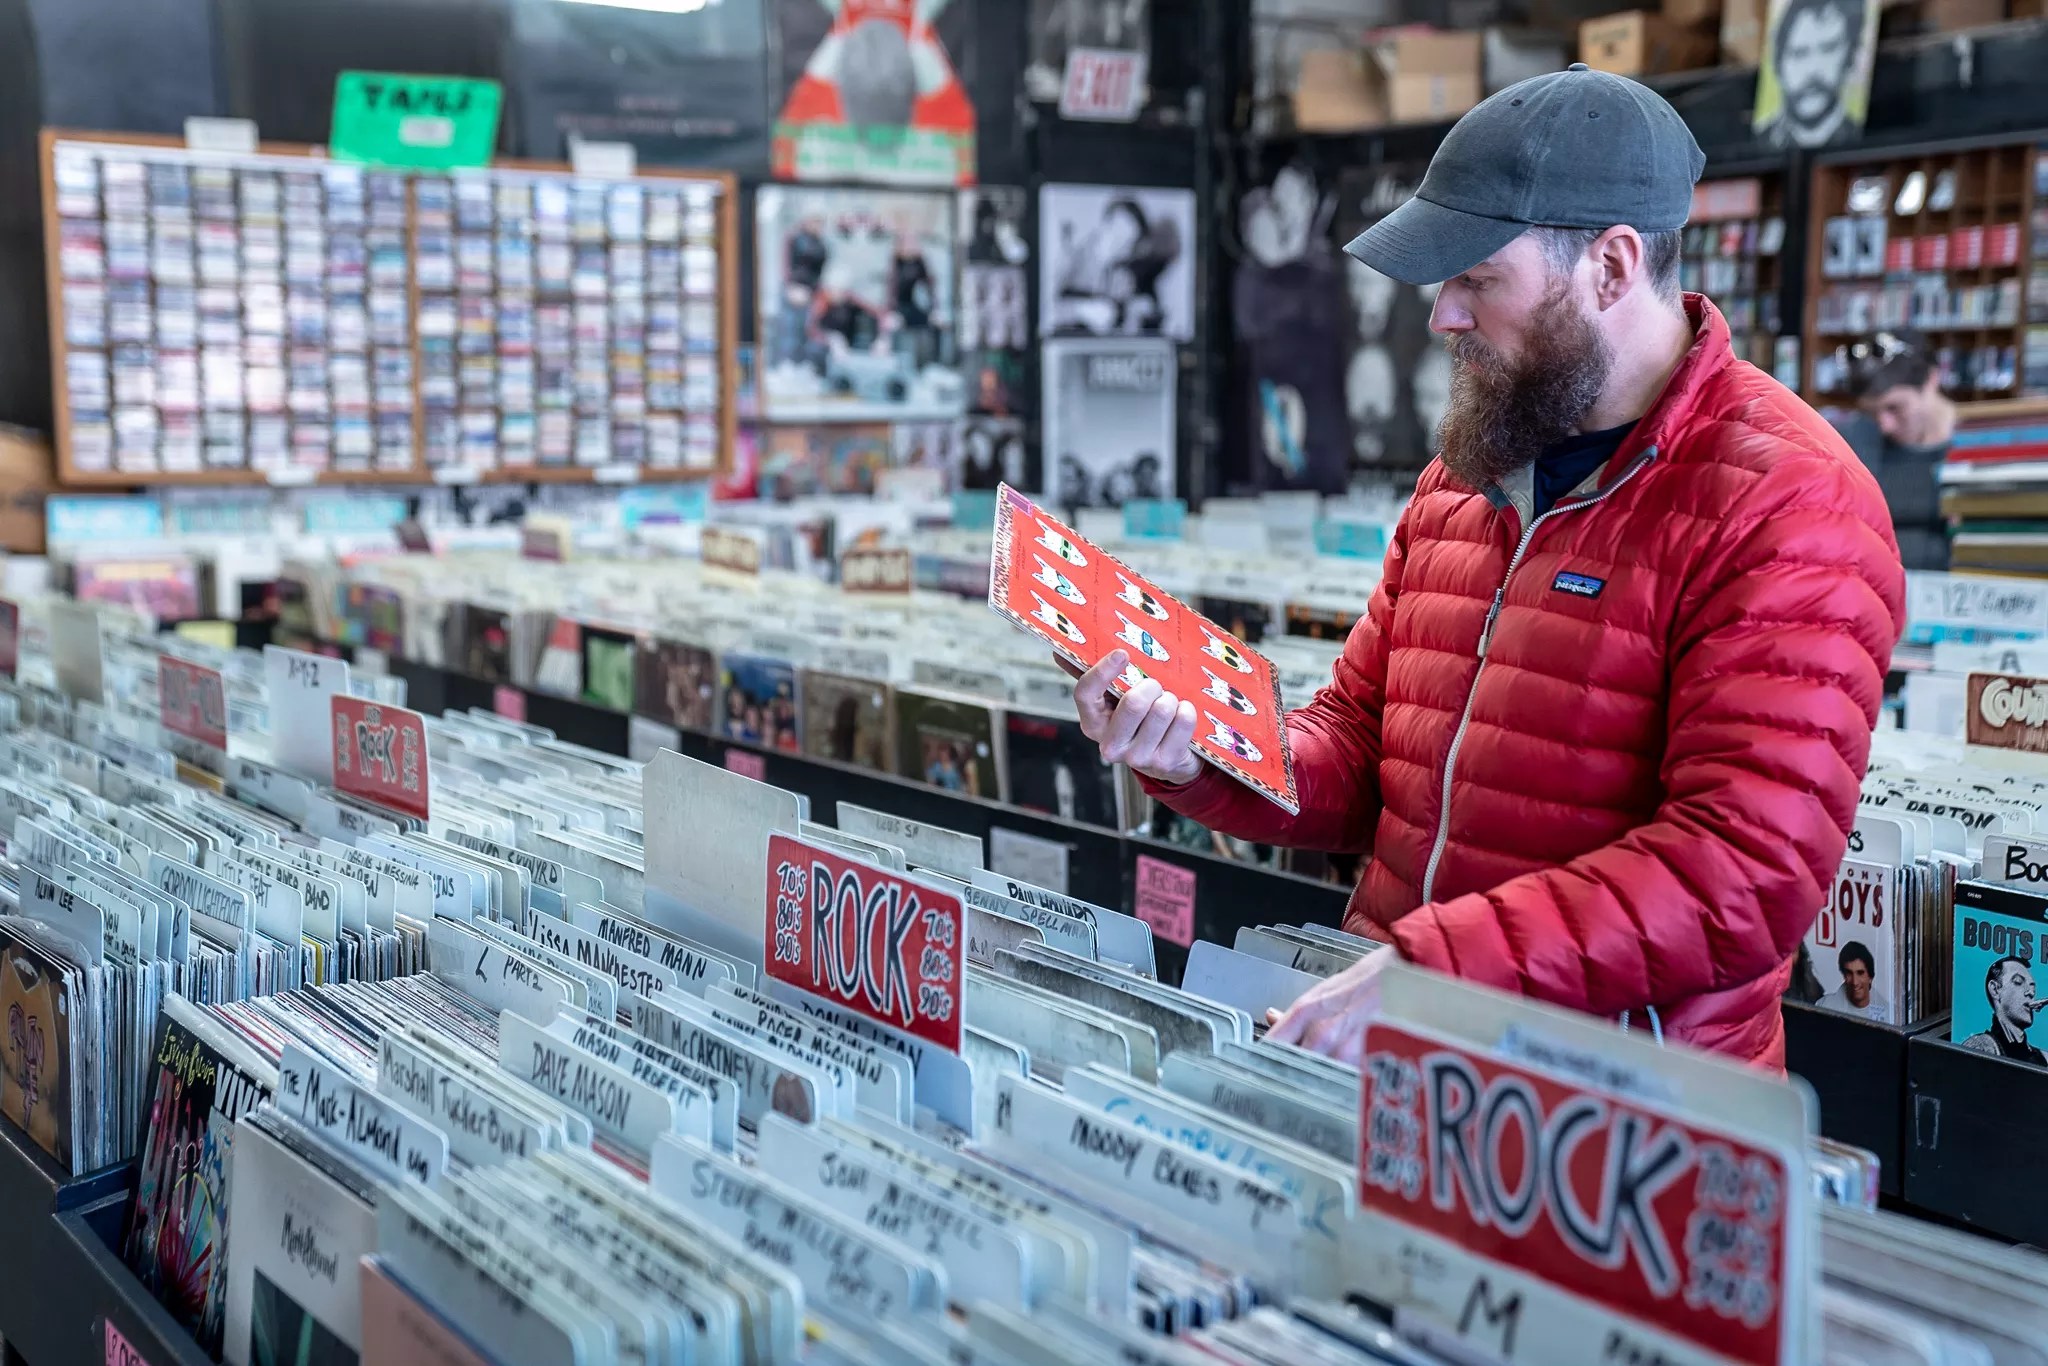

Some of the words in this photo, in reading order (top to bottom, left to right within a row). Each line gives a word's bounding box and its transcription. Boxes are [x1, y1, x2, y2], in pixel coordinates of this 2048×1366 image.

[1555, 581, 1594, 595] patagonia
[58, 889, 75, 913] LEE
[598, 917, 651, 959] MANFRED
[660, 943, 708, 981] MANN
[810, 859, 922, 1028] ROCK
[1963, 917, 2034, 961] BOOTS
[531, 1041, 571, 1097] DAVE
[571, 1063, 631, 1131] MASON
[1420, 1052, 1696, 1299] ROCK
[1457, 1274, 1526, 1356] M
